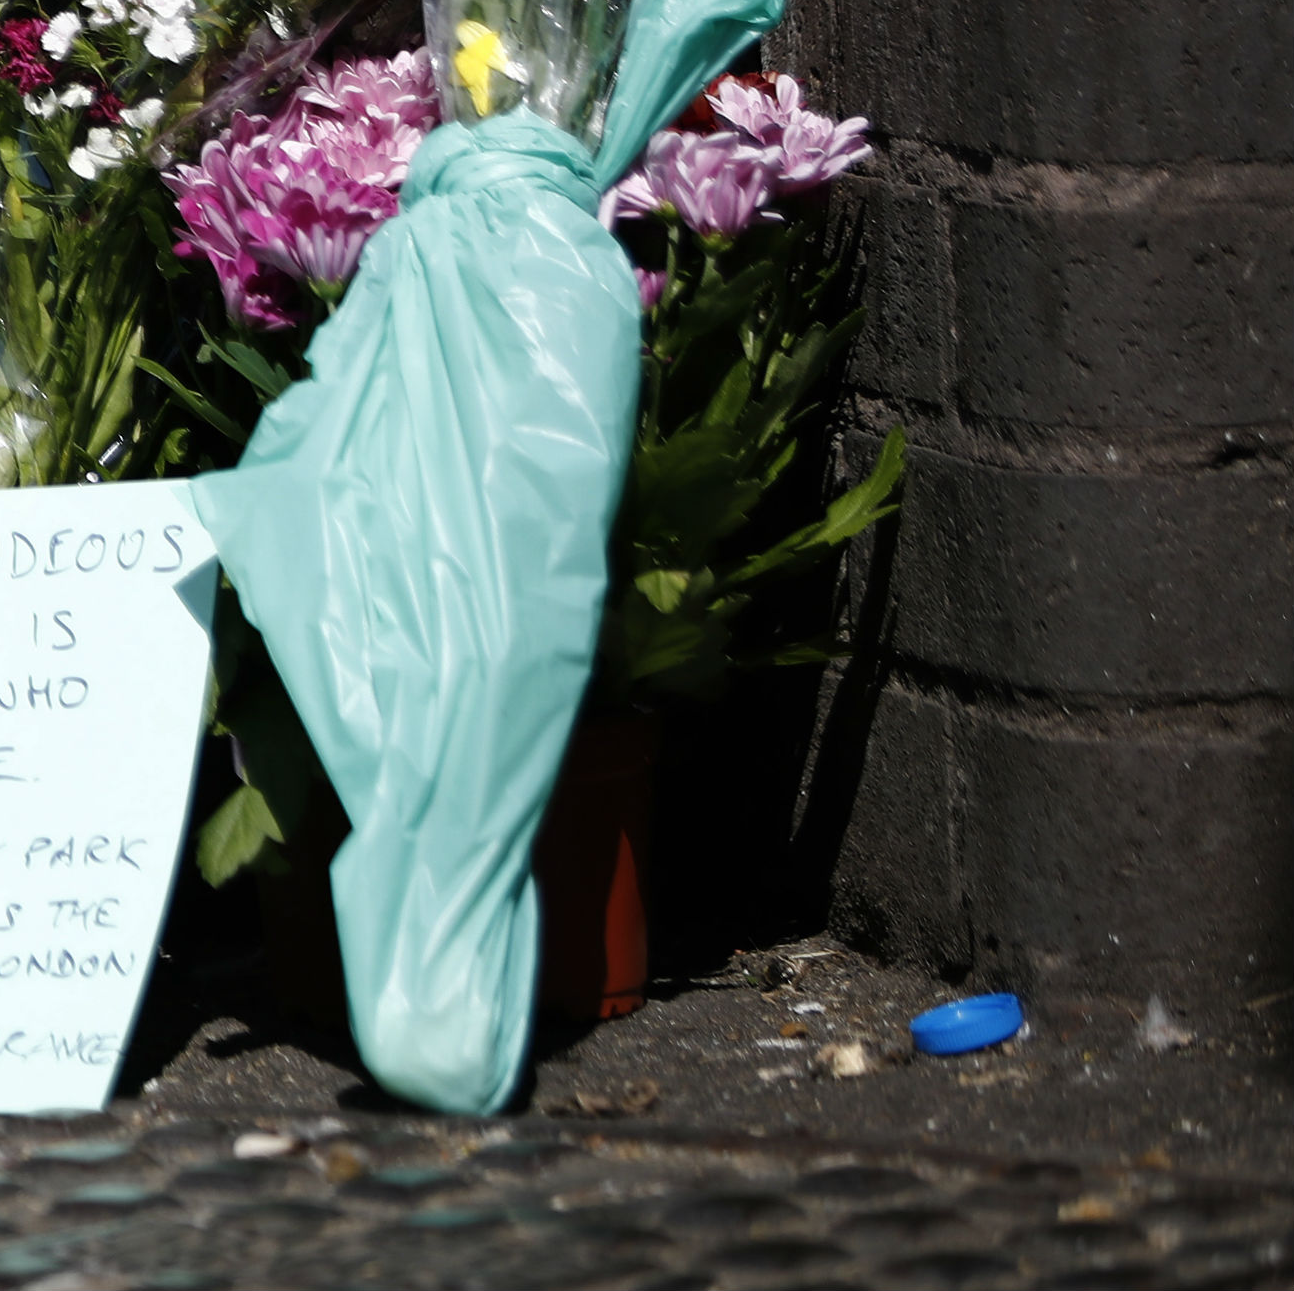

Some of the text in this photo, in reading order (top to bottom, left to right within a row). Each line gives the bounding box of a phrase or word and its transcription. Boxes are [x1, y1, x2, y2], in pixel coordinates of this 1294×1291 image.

[32, 609, 78, 652] IS
[23, 834, 148, 871] PARK
[48, 896, 121, 932] THE
